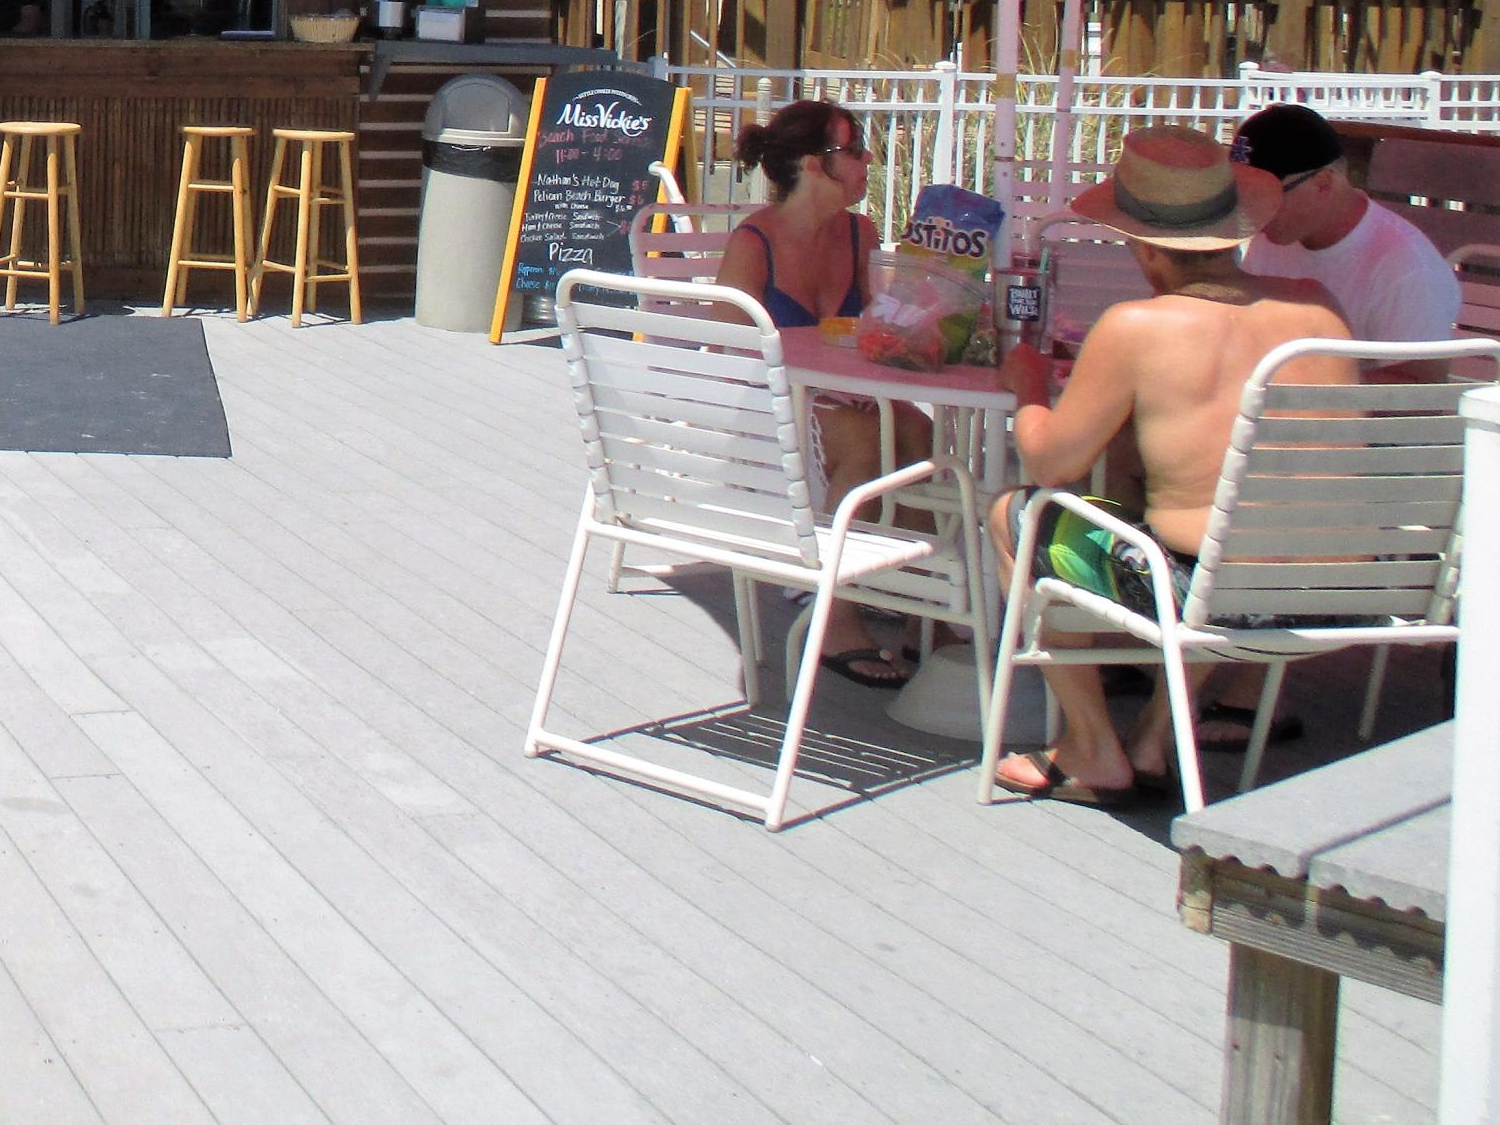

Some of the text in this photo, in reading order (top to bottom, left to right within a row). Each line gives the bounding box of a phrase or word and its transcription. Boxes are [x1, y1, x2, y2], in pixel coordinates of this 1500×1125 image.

[556, 101, 653, 138] Miss Vickie's
[536, 174, 580, 187] Nathan's
[581, 175, 601, 188] Hot
[602, 177, 620, 195] Dog
[533, 189, 564, 203] Pelican
[565, 189, 592, 202] Beach
[593, 189, 626, 208] Burger
[549, 243, 594, 266] Pizza
